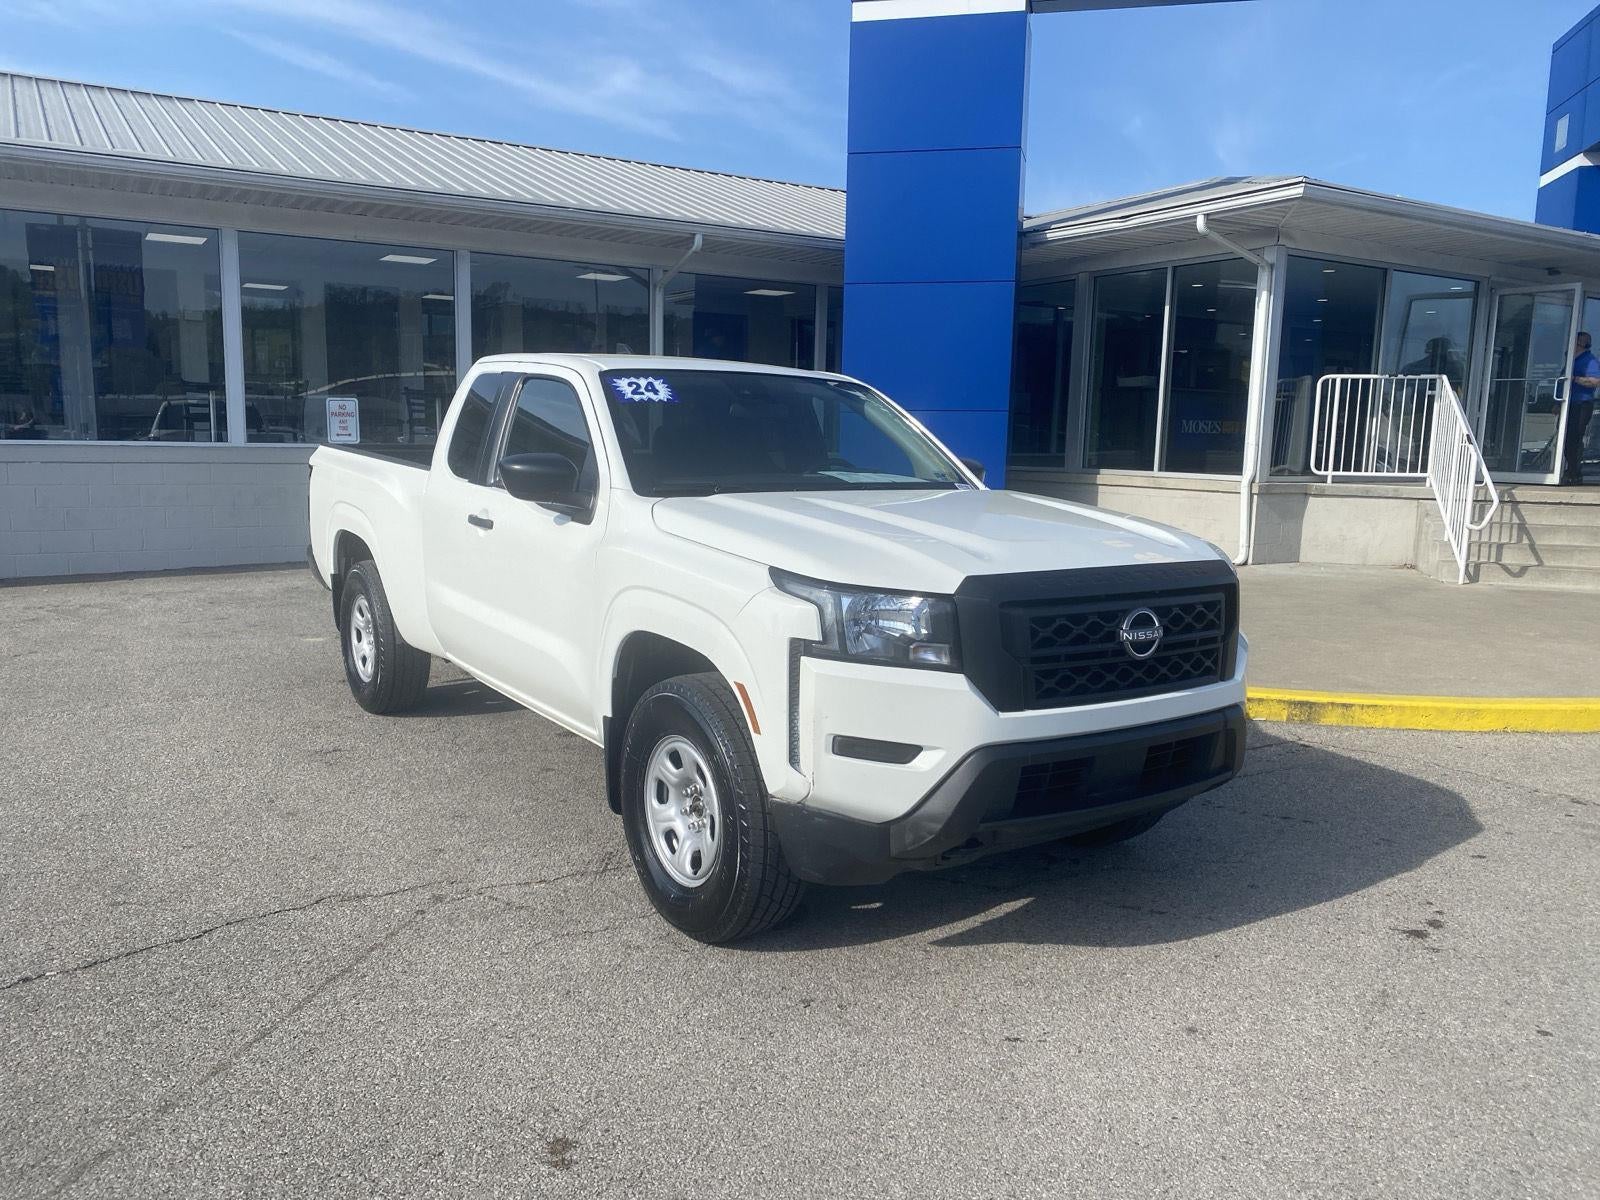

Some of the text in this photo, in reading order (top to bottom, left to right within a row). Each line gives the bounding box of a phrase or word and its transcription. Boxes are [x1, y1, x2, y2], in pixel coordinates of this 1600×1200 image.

[627, 381, 660, 396] 24
[1181, 419, 1221, 434] MOSES
[1123, 629, 1163, 640] NISSAN
